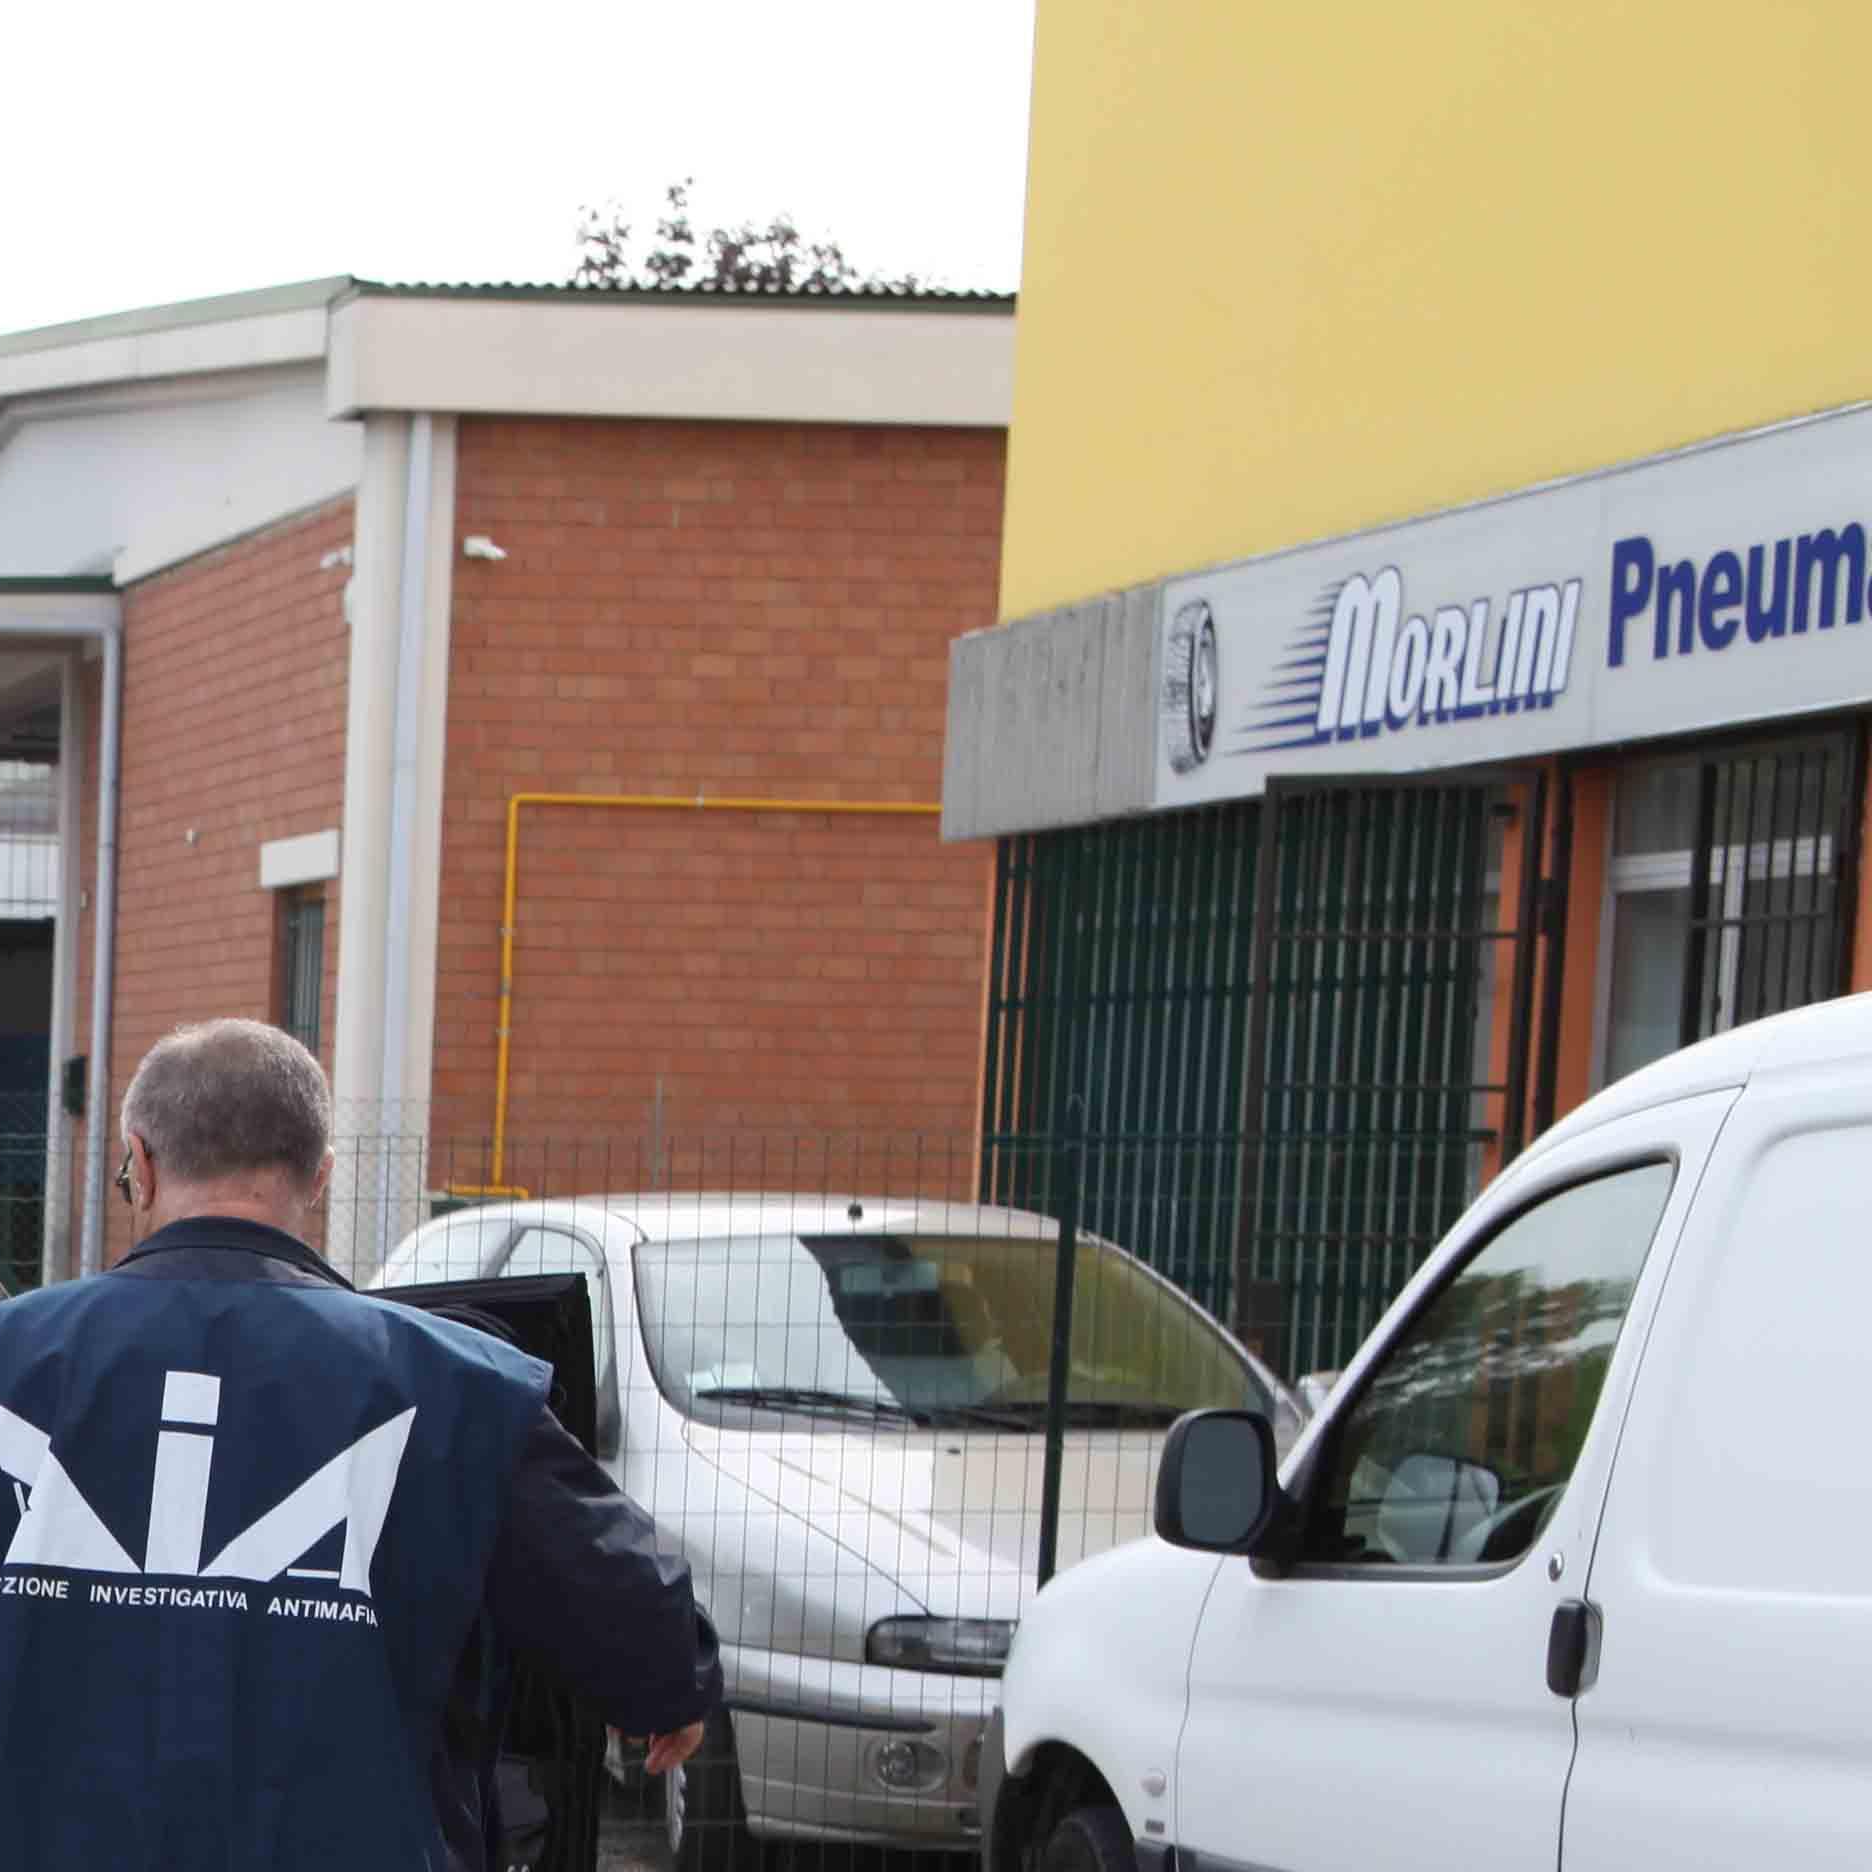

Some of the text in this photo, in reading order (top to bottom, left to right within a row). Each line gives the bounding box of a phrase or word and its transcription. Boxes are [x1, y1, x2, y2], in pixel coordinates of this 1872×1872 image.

[1607, 521, 1872, 668] Pneum
[89, 1584, 249, 1612] INVESTIGATIVA
[267, 1596, 379, 1627] ANTIMAFIA
